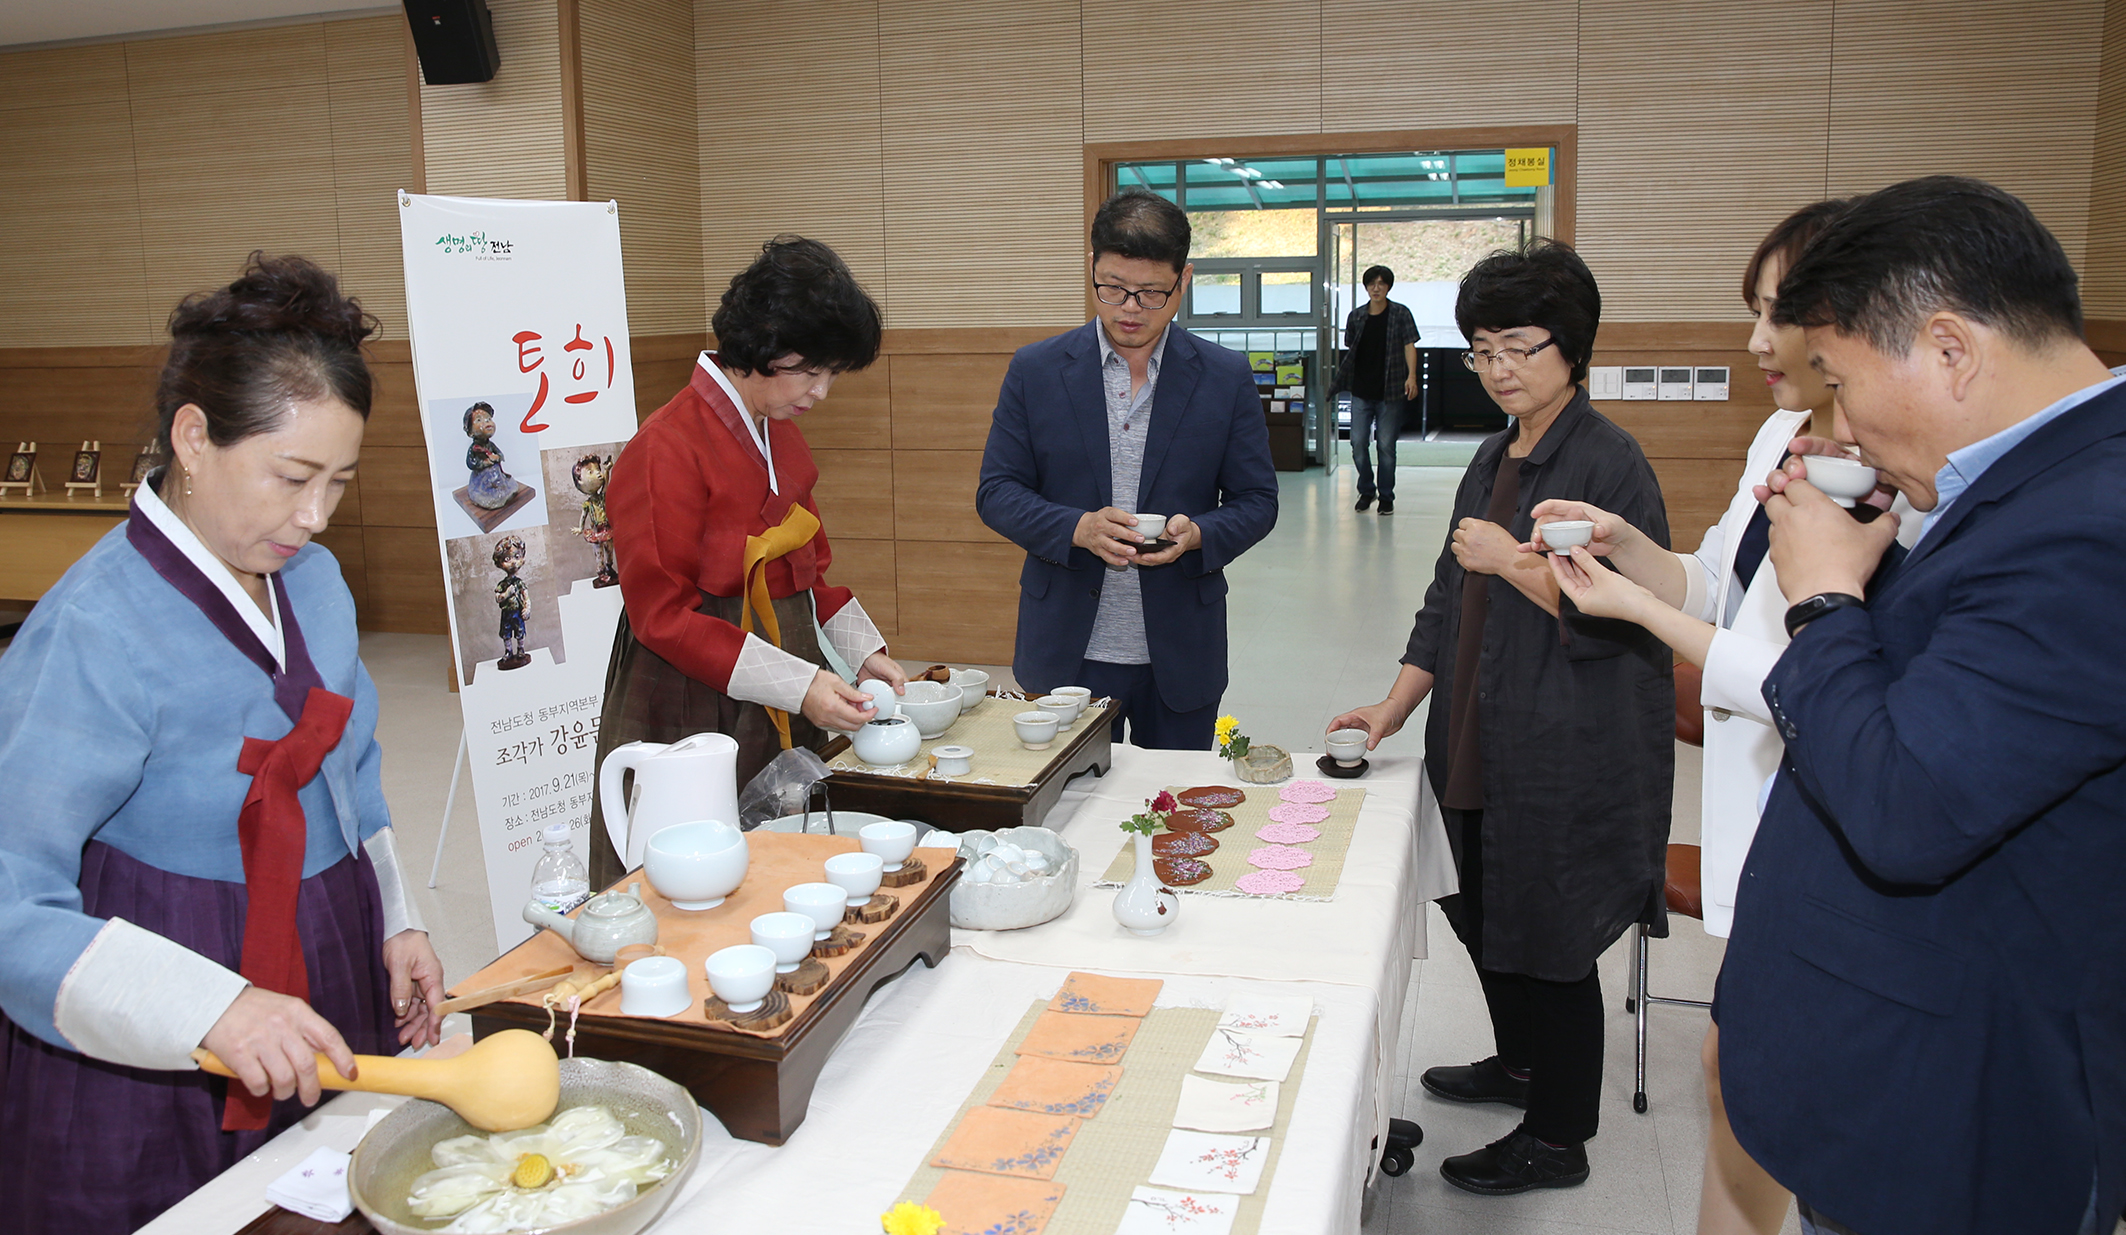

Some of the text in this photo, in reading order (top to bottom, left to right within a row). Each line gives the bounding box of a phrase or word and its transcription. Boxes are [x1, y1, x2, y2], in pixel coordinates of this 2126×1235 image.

[490, 240, 514, 254] 전남
[490, 694, 599, 735] 전남도청 동부지역본부
[496, 736, 544, 766] 조각가
[502, 792, 520, 808] 기간
[505, 815, 524, 831] 장소
[530, 799, 566, 822] 전남도청
[508, 836, 533, 853] open
